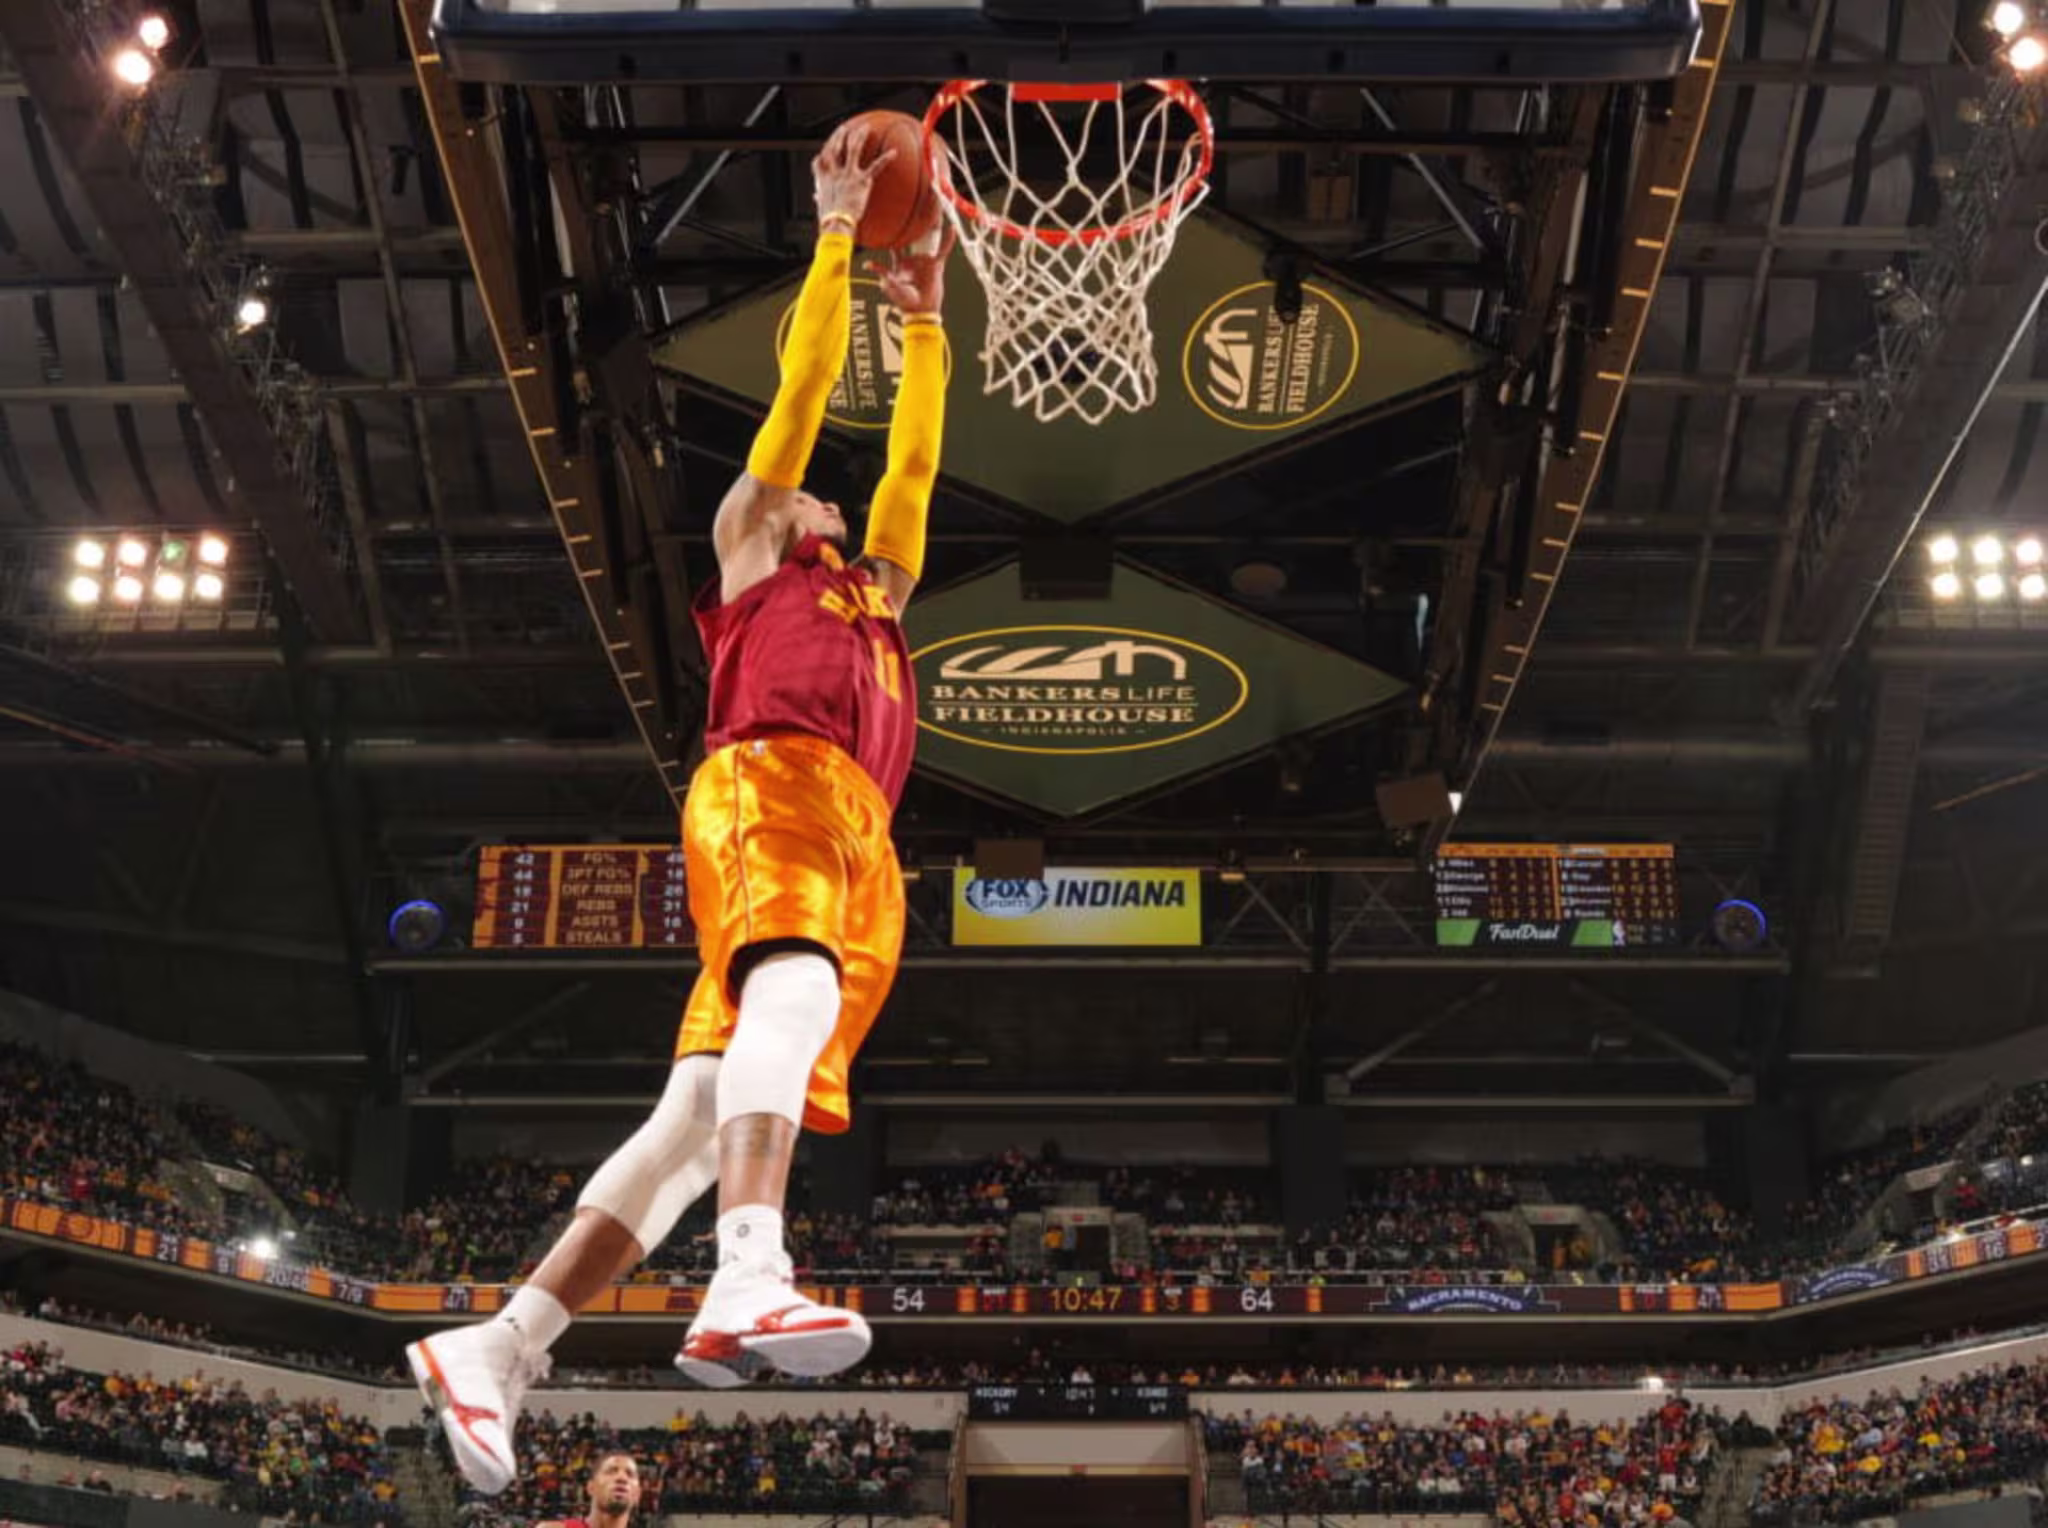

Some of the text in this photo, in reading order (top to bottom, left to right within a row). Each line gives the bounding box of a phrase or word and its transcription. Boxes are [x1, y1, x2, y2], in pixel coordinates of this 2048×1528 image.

[1286, 303, 1319, 412] FIELDHOUSE
[1258, 337, 1282, 412] BANKERS
[931, 686, 1195, 702] BANKERS LIFE
[933, 706, 1195, 723] FIELDHOUSE
[562, 884, 591, 895] DEF
[982, 879, 1186, 907] FOX INDIANA
[566, 931, 621, 943] STEALS
[1490, 923, 1560, 943] FanDuel
[156, 1242, 178, 1262] 21
[893, 1287, 926, 1312] 54
[1051, 1287, 1122, 1311] 10:47
[1241, 1288, 1274, 1312] 64
[1408, 1288, 1523, 1311] SACRAMENTO
